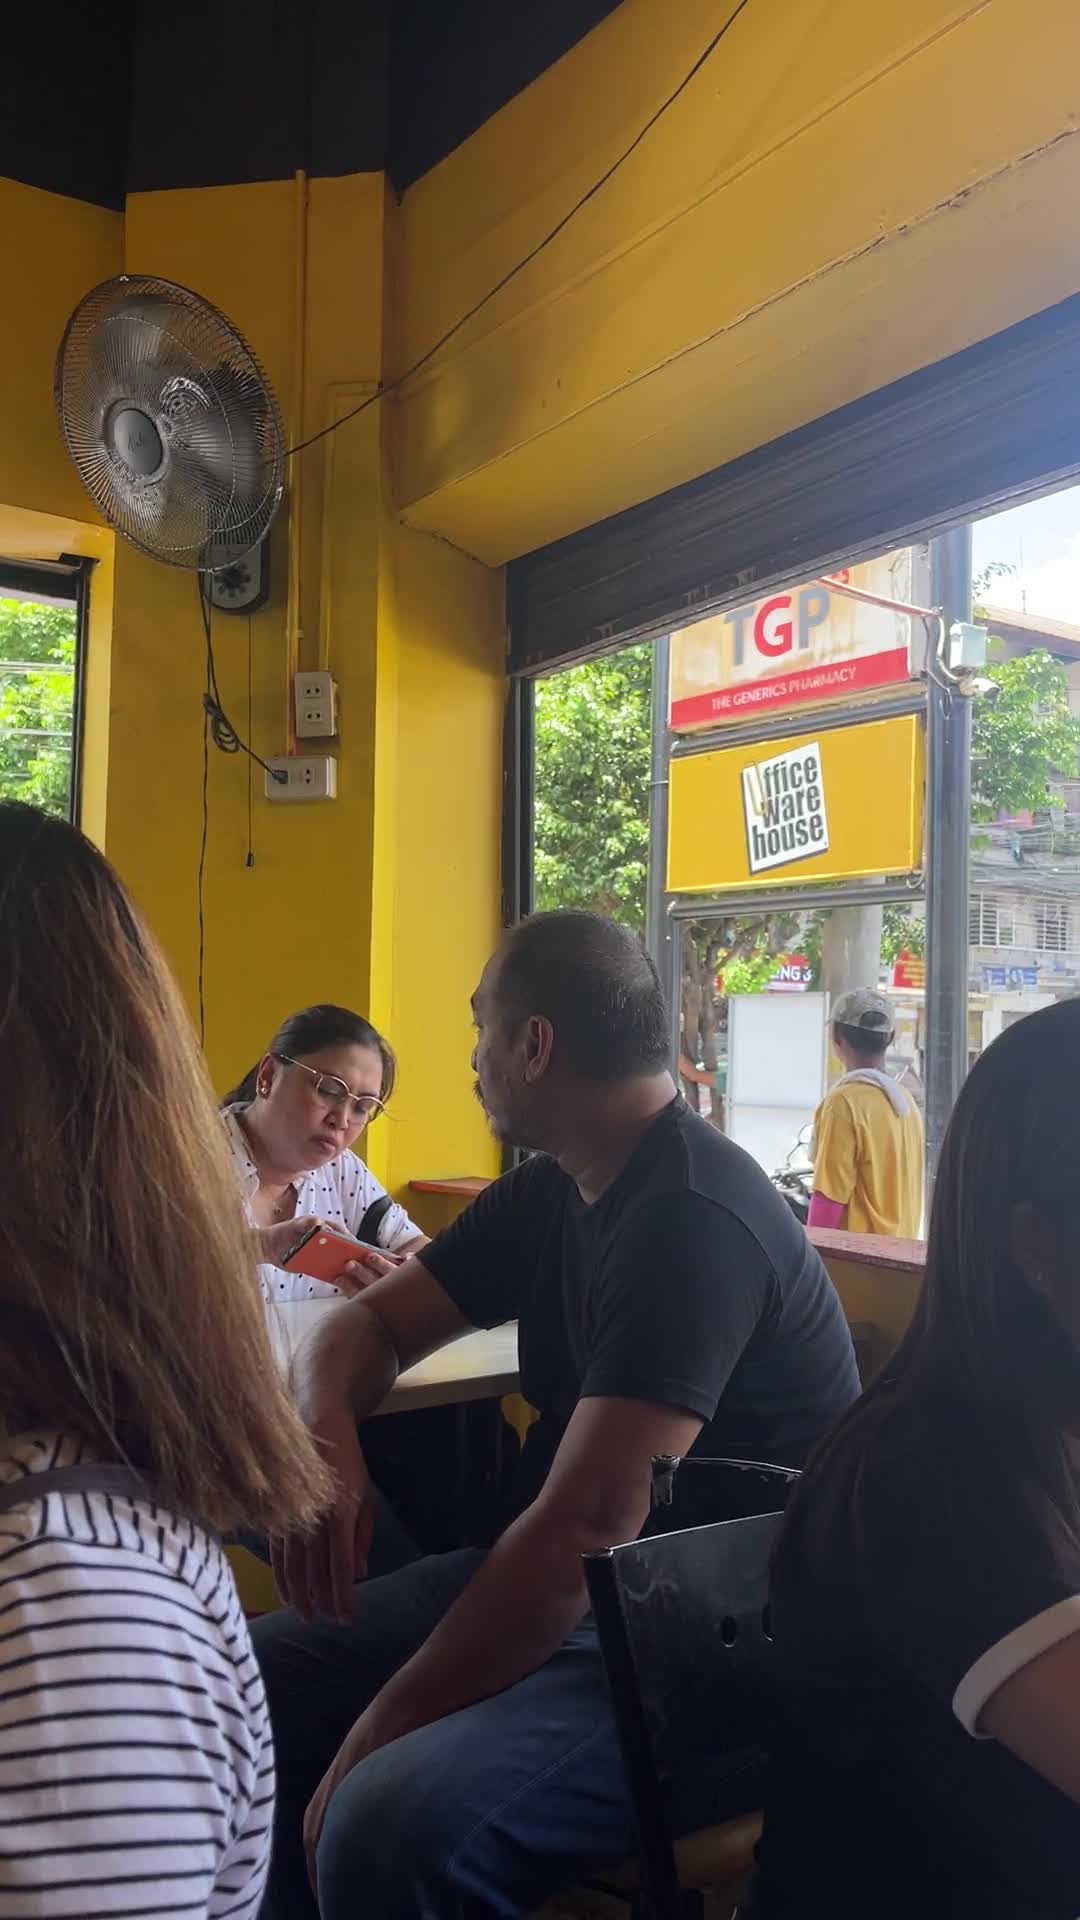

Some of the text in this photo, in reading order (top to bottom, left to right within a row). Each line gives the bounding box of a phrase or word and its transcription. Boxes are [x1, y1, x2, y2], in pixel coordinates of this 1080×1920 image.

[724, 586, 830, 666] TGP
[711, 665, 857, 711] THE GENERICS PHARMACY
[761, 785, 821, 828] ware
[752, 814, 824, 861] house
